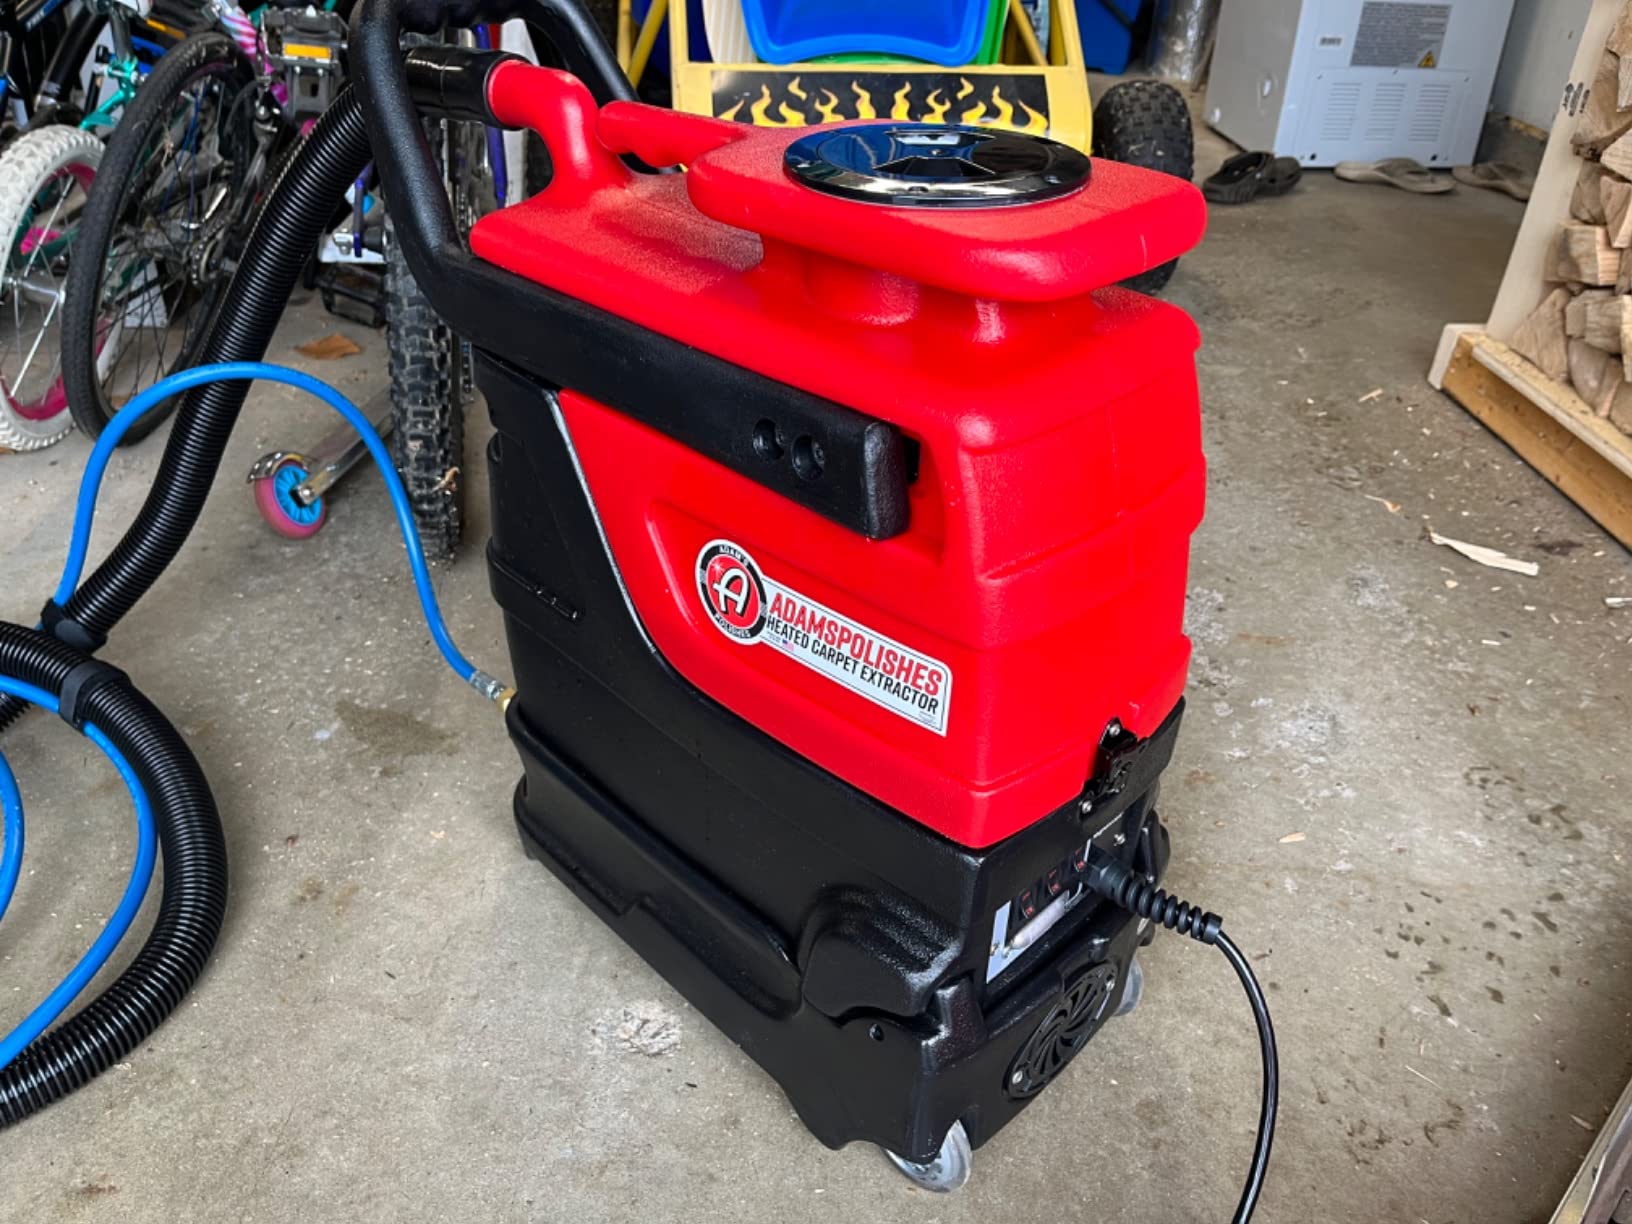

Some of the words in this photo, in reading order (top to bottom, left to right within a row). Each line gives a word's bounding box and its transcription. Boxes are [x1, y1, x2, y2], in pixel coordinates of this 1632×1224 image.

[766, 615, 809, 649] HEATED
[811, 639, 860, 675] CARPET
[860, 665, 939, 715] EXTRACTOR
[769, 592, 943, 696] ADAMSPOLISHES
